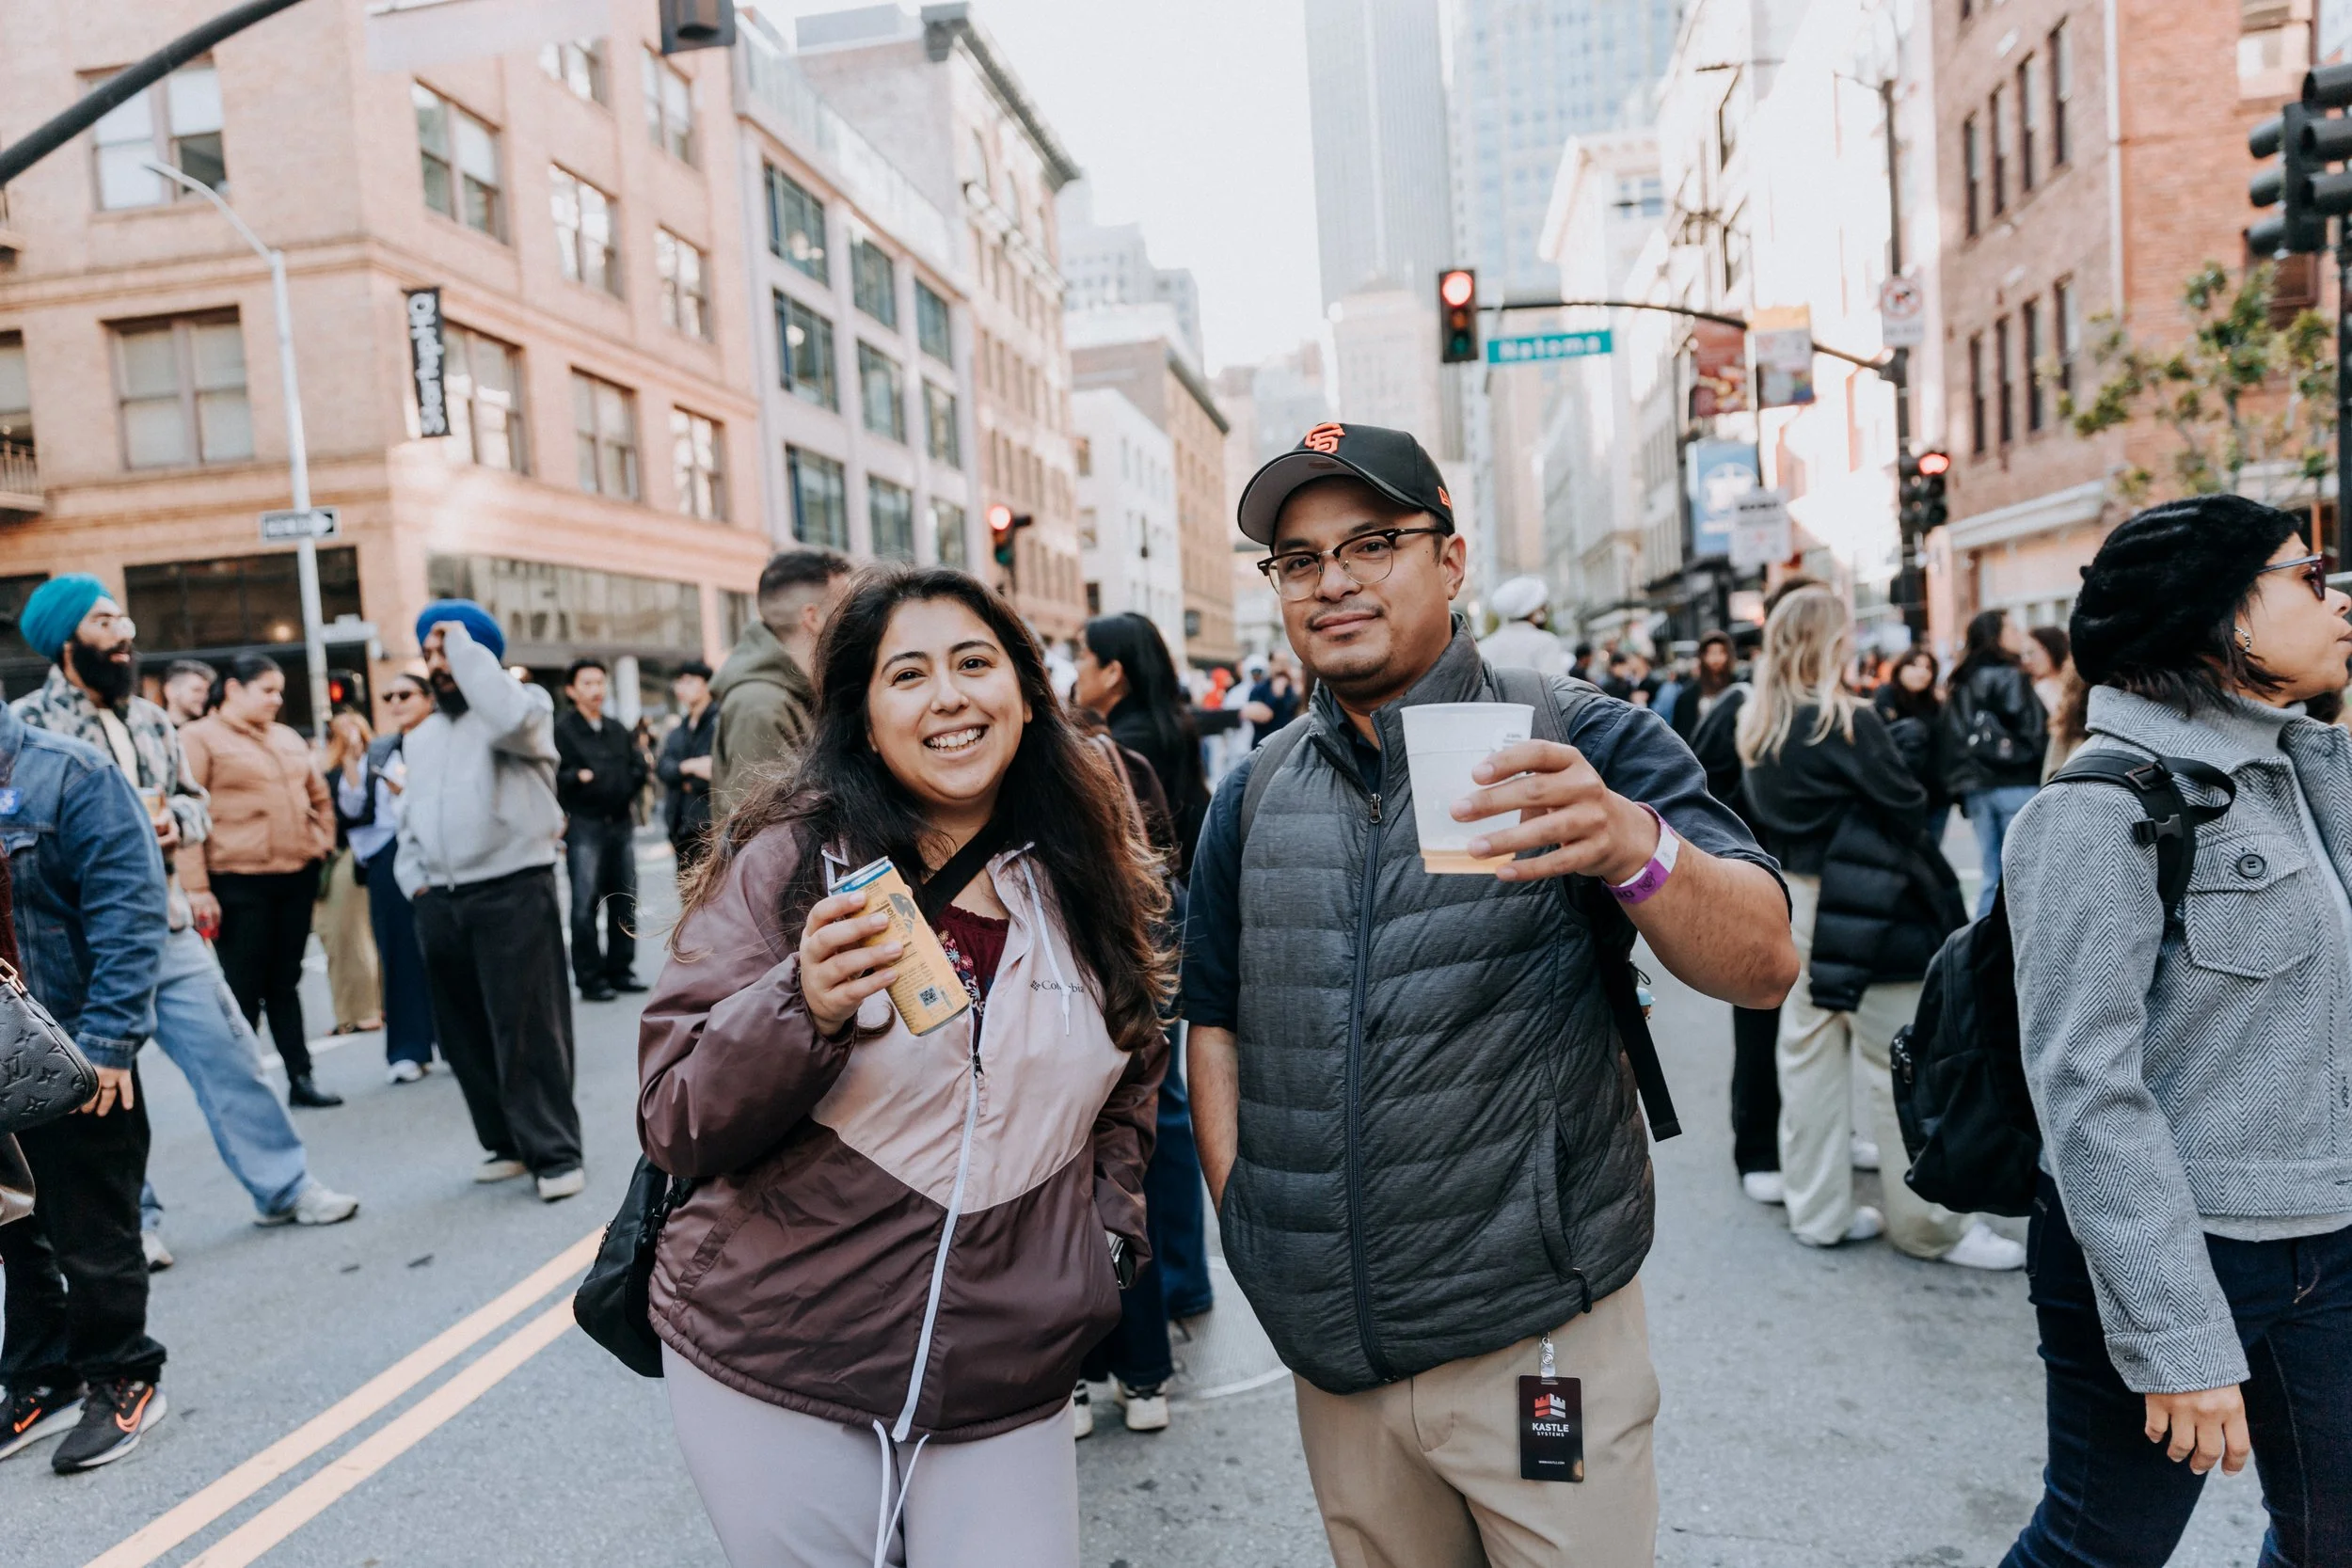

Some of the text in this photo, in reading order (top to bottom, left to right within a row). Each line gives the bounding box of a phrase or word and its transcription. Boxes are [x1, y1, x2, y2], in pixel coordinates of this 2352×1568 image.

[1499, 336, 1601, 360] Natoma
[1041, 980, 1084, 993] Colbia
[1533, 1422, 1569, 1433] KASTLE
